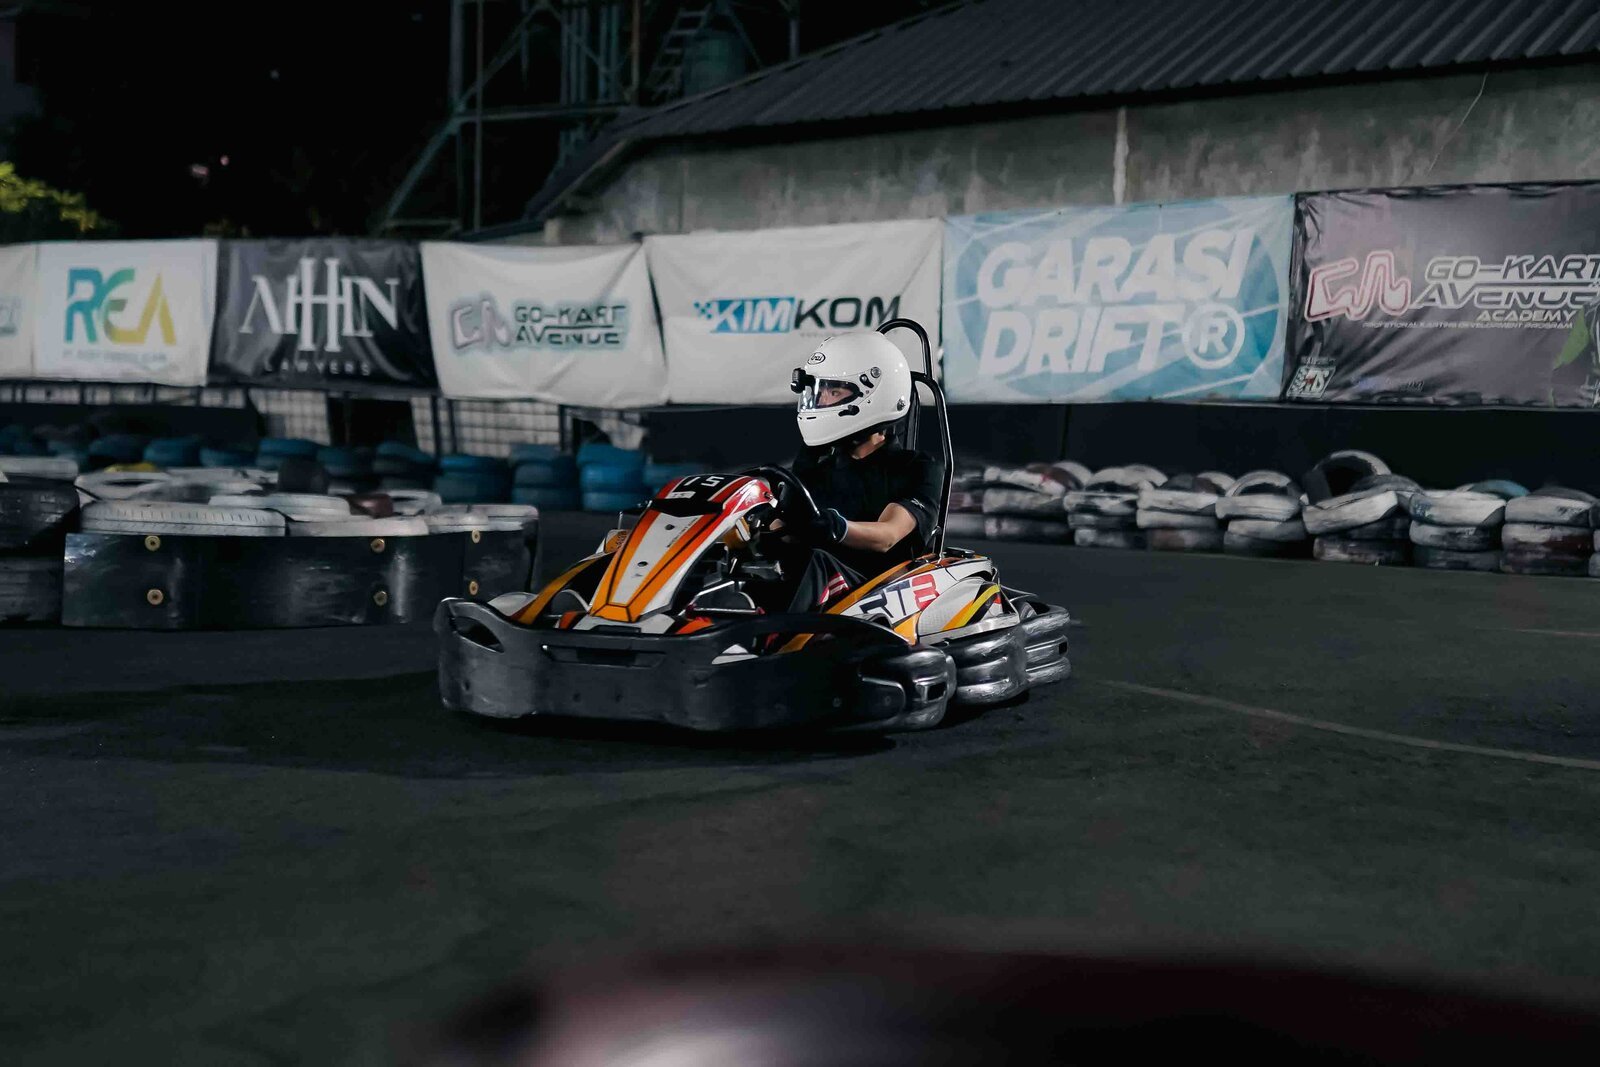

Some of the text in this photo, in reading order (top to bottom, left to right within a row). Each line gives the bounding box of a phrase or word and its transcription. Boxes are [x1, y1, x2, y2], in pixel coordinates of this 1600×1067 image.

[977, 230, 1254, 309] GARASI
[1476, 309, 1577, 322] ACADEMY
[514, 326, 620, 345] AVENUE
[264, 359, 371, 376] LAWYERS
